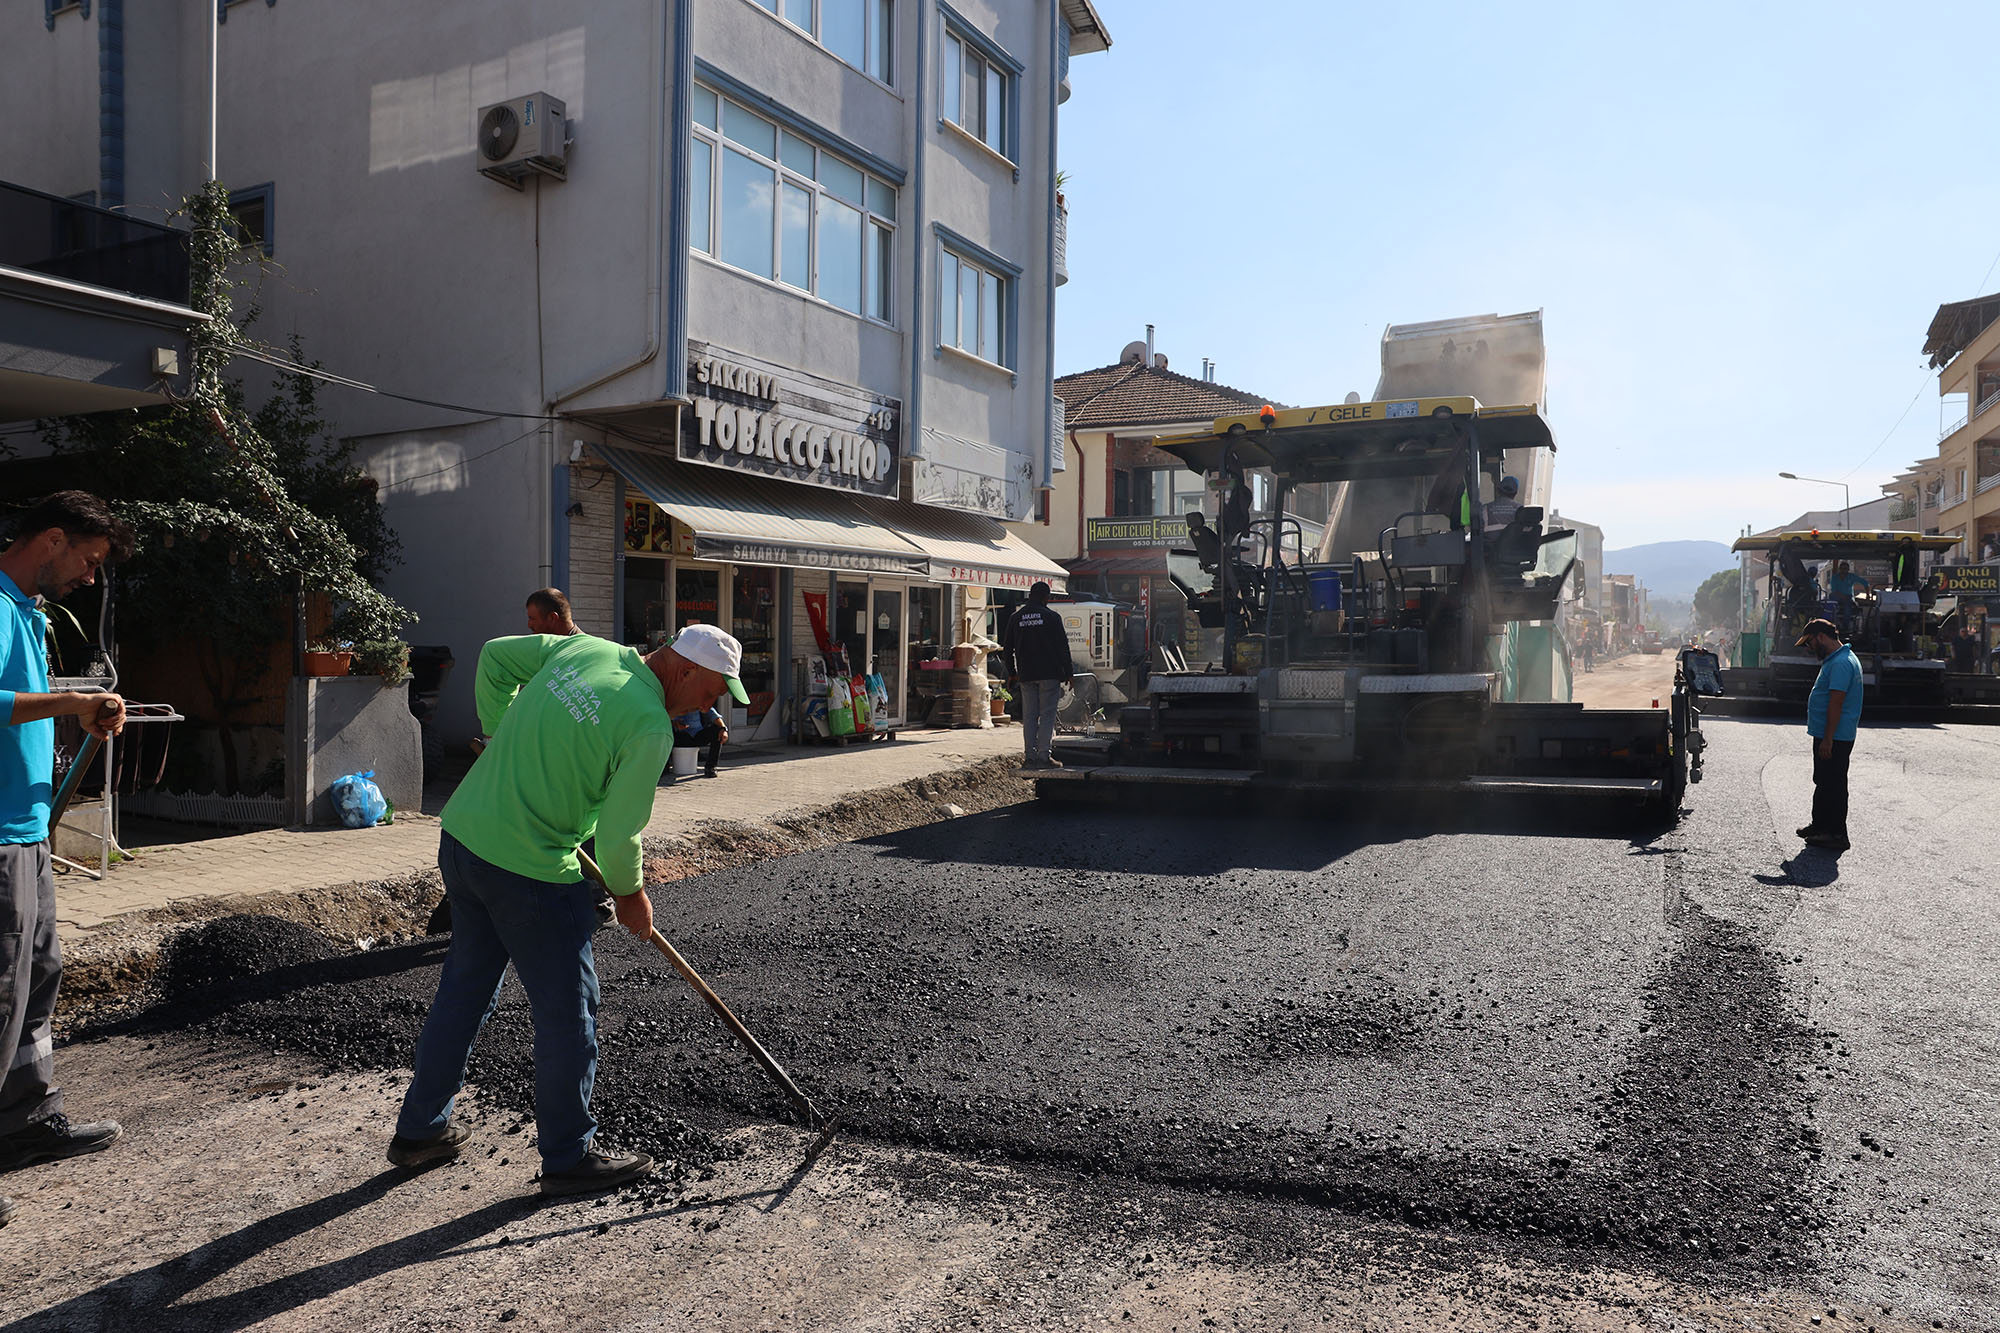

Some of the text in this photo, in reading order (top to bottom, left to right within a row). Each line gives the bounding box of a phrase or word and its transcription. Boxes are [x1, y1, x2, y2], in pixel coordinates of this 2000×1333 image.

[696, 358, 780, 401] SAKARYA
[868, 409, 892, 432] +18
[694, 398, 891, 482] TOBACCO SHOP
[1089, 521, 1110, 542] HAIR
[1112, 525, 1127, 538] CUT
[1129, 524, 1151, 537] CLUB
[1153, 519, 1185, 540] ERKEK
[733, 544, 909, 572] SAKARYA TOBACCO SHOP
[950, 567, 989, 583] SELVİ
[1949, 577, 1998, 590] DÖNER
[1957, 567, 1990, 577] ÜNLÜ
